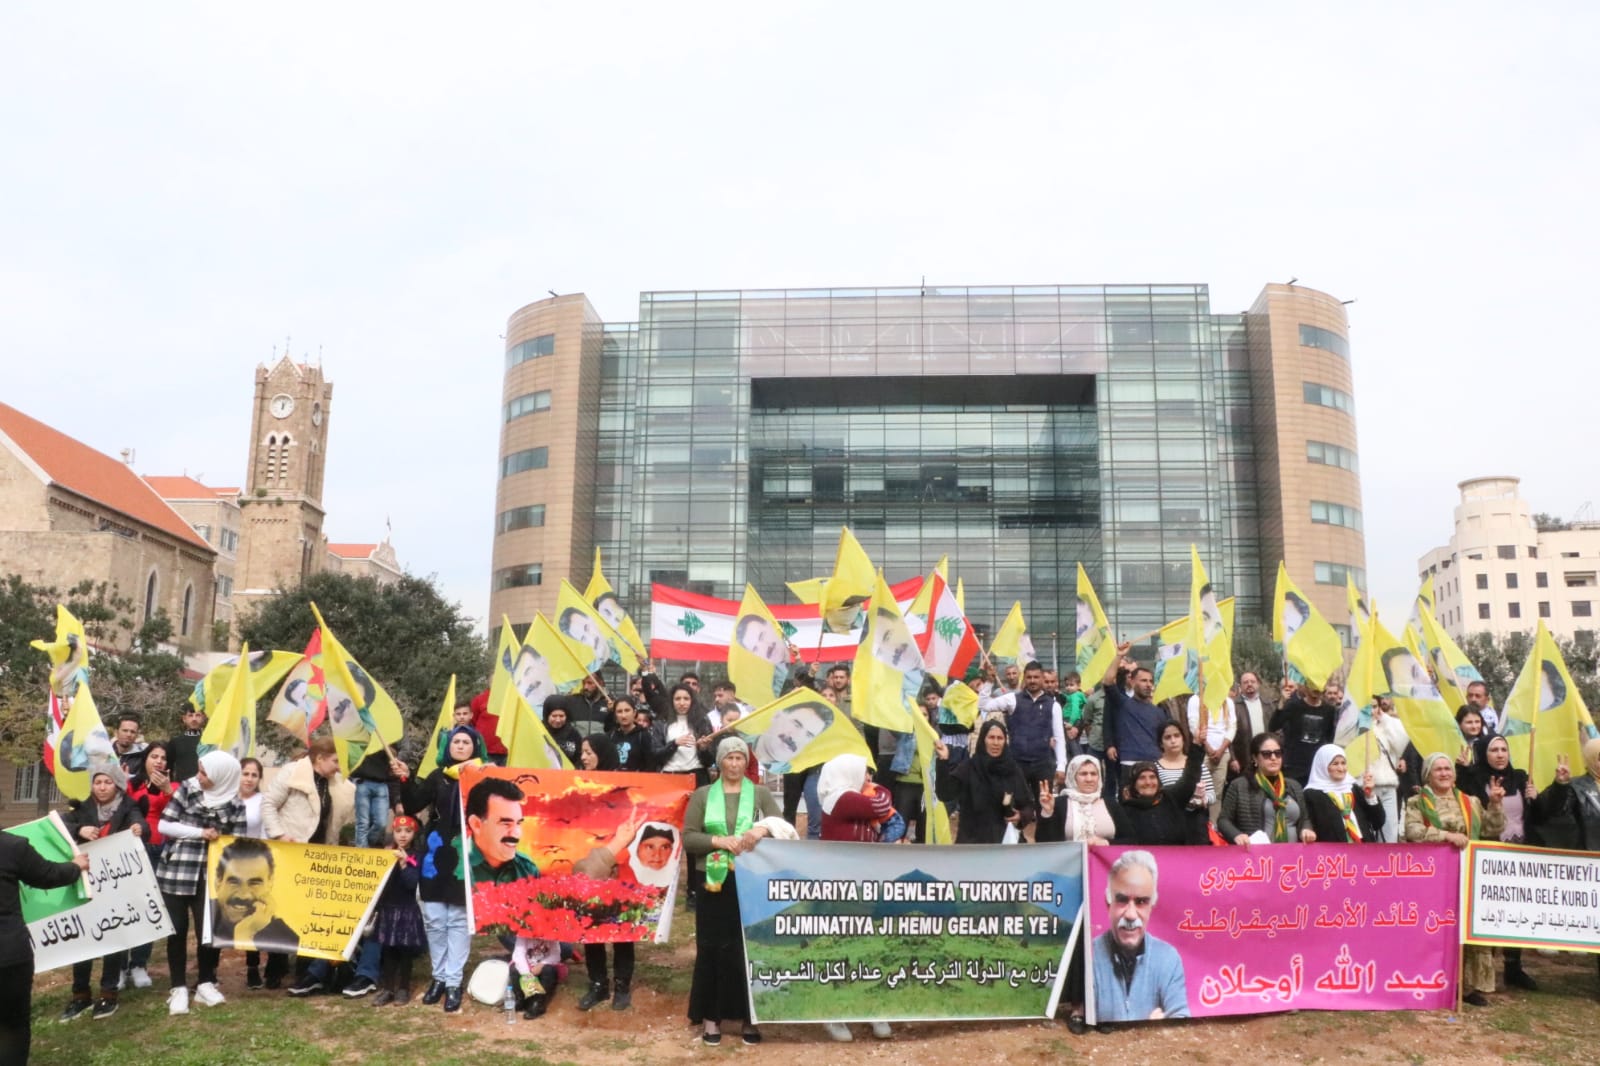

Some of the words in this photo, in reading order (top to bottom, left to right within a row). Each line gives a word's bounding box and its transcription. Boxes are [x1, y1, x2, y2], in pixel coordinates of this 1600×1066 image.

[129, 849, 143, 875] لا
[304, 849, 338, 863] Azadiya
[376, 856, 388, 867] Bo
[310, 862, 342, 876] Abdula
[1364, 853, 1435, 885] نطالب
[1482, 858, 1517, 877] CIVAKA
[1519, 861, 1593, 883] NAVNETEWEYÎ
[343, 878, 379, 892] Demokr
[1200, 856, 1273, 896] الفوري
[1279, 854, 1357, 893] بالإفراج
[305, 888, 314, 898] Ji
[316, 889, 328, 899] Bo
[330, 890, 352, 902] Doza
[355, 893, 373, 904] Kur
[768, 880, 859, 901] HEVKARIYA
[862, 881, 879, 901] BI
[883, 881, 956, 902] DEWLETA
[959, 882, 1029, 902] TURKIYE
[1481, 884, 1533, 904] PARASTINA
[1535, 886, 1559, 906] GELÊ
[1561, 889, 1589, 908] KURD
[91, 903, 141, 941] شخص
[145, 893, 163, 931] في
[1177, 904, 1309, 939] الديمقراطية
[1314, 898, 1367, 929] الأمة
[1373, 901, 1418, 927] قائد
[40, 914, 86, 947] القائد
[775, 915, 874, 935] DIJMINATIYA
[878, 916, 893, 935] JI
[898, 916, 944, 935] HEMU
[947, 916, 999, 935] GELAN
[1003, 916, 1024, 935] RE
[758, 961, 814, 987] الشعوب
[819, 961, 846, 983] لكل
[850, 962, 882, 981] عداء
[887, 966, 907, 988] هي
[911, 960, 962, 985] التركية
[966, 960, 1005, 984] الدولة
[1009, 969, 1027, 987] مع
[1200, 954, 1303, 1006] أوجلان
[1385, 970, 1448, 1000] عبد
